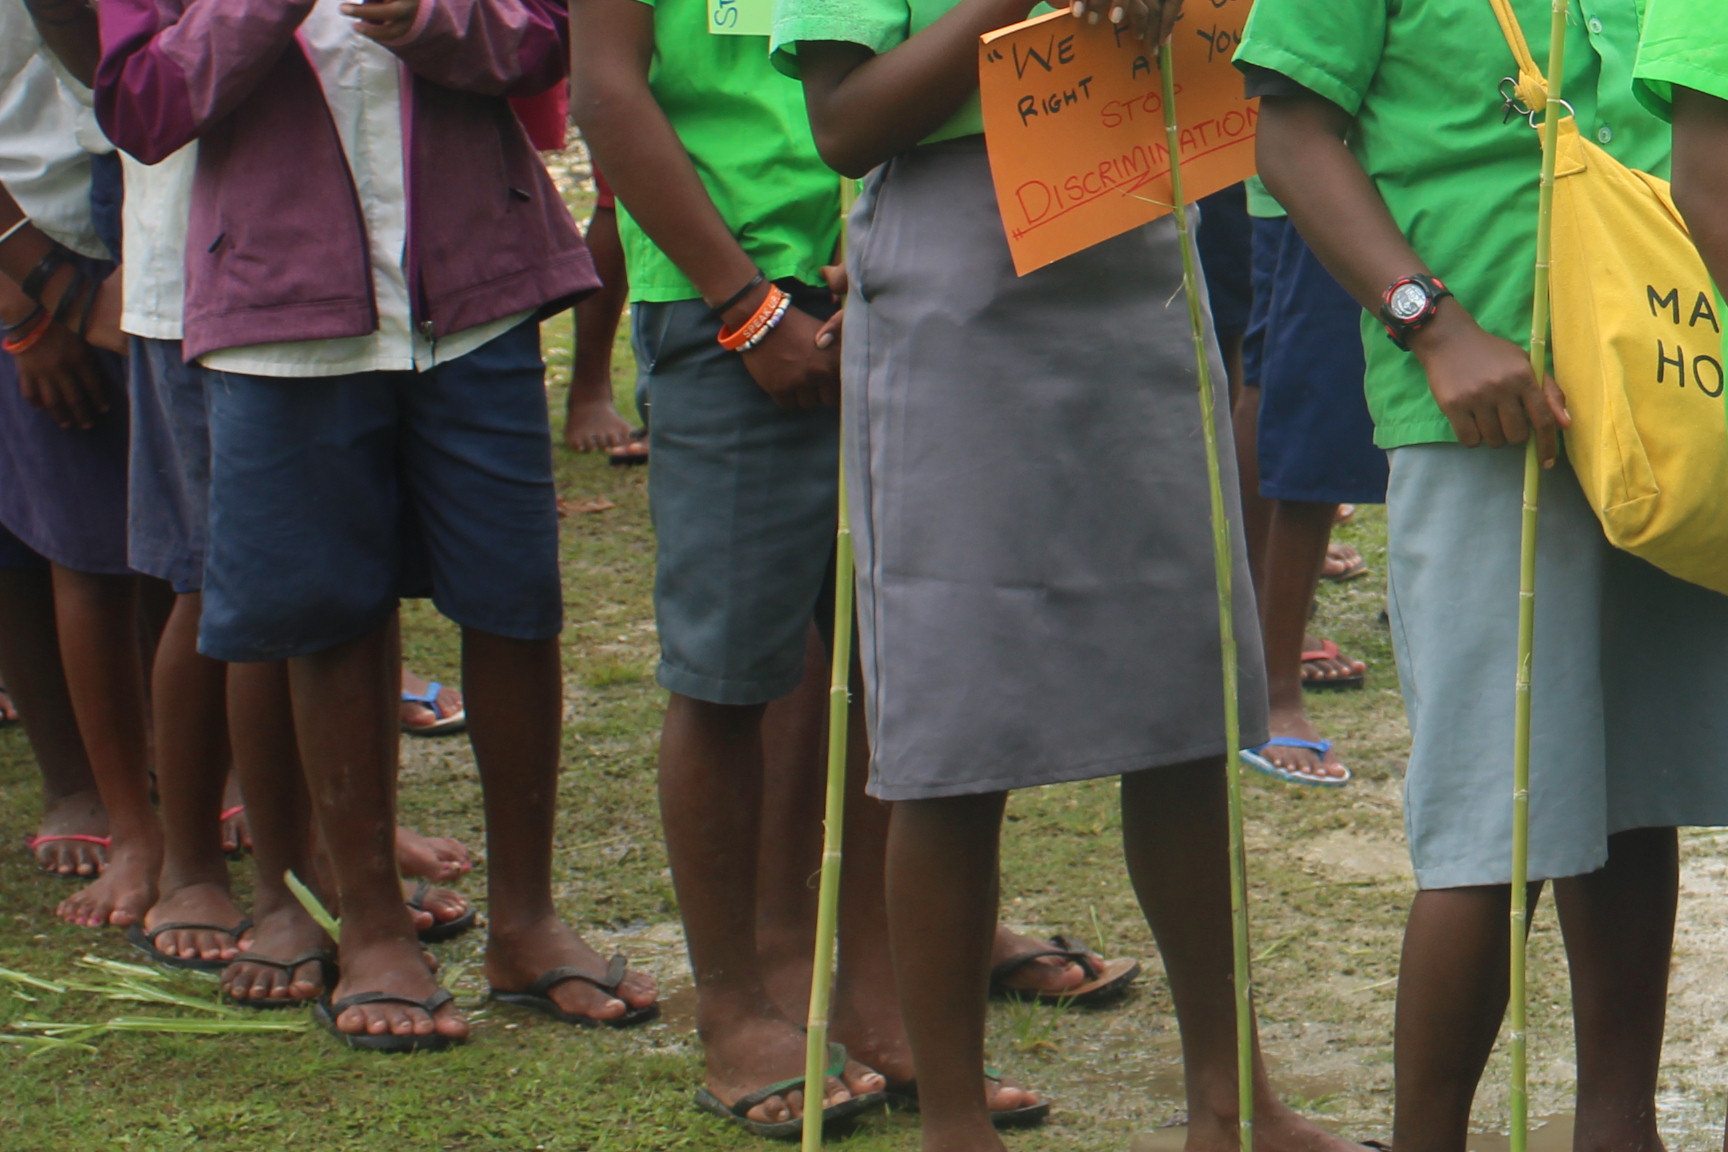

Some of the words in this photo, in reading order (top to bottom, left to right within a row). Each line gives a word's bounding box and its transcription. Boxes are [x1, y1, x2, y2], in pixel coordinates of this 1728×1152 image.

[1017, 76, 1093, 128] RIGHT
[1016, 106, 1259, 225] DISCRIMINATION
[1647, 284, 1719, 334] MA
[1657, 339, 1724, 397] HO
